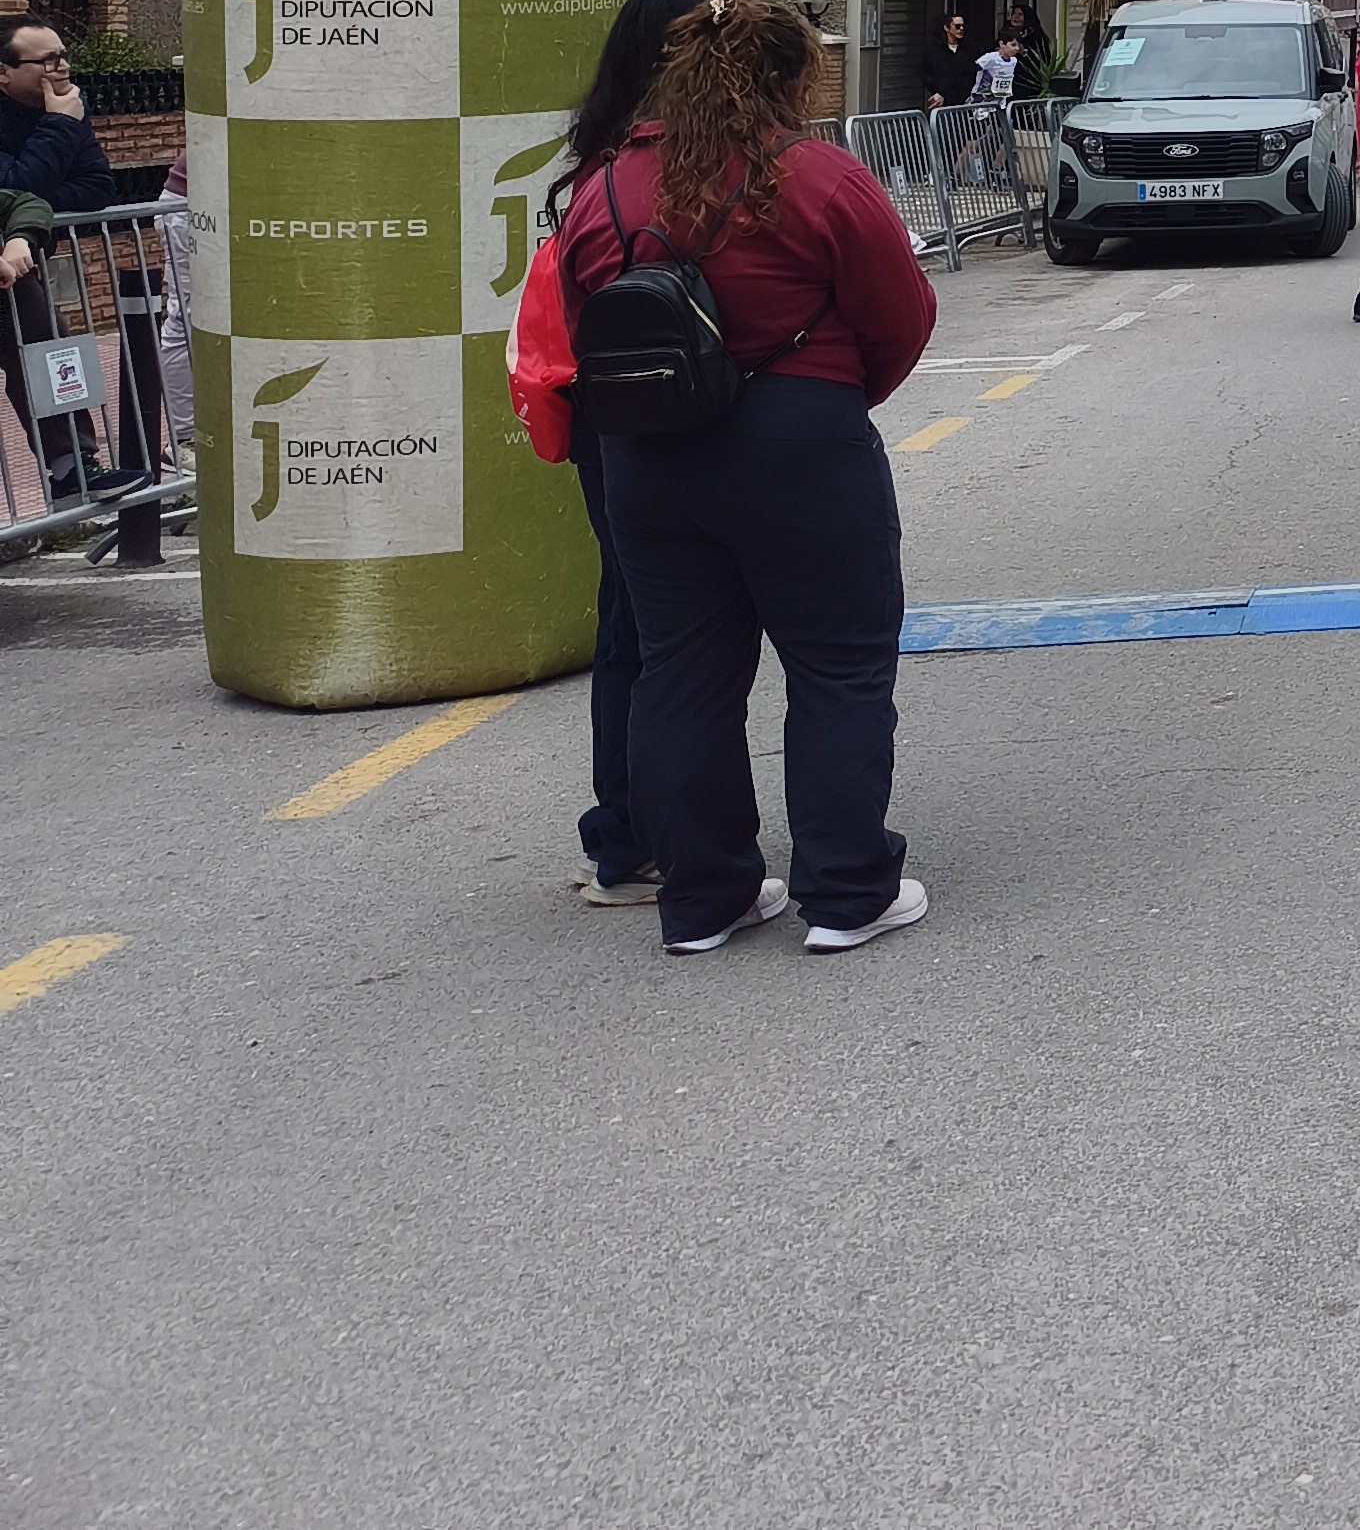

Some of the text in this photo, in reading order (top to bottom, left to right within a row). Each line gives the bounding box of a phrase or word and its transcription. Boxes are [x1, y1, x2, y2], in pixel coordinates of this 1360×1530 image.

[283, 25, 378, 45] DE JAÉN
[1170, 146, 1192, 156] Ford
[1150, 184, 1220, 198] 4983 NFX
[250, 220, 427, 238] DEPORTES
[288, 435, 436, 458] DIPUTACIÓN
[288, 464, 382, 485] DE JAÉN
